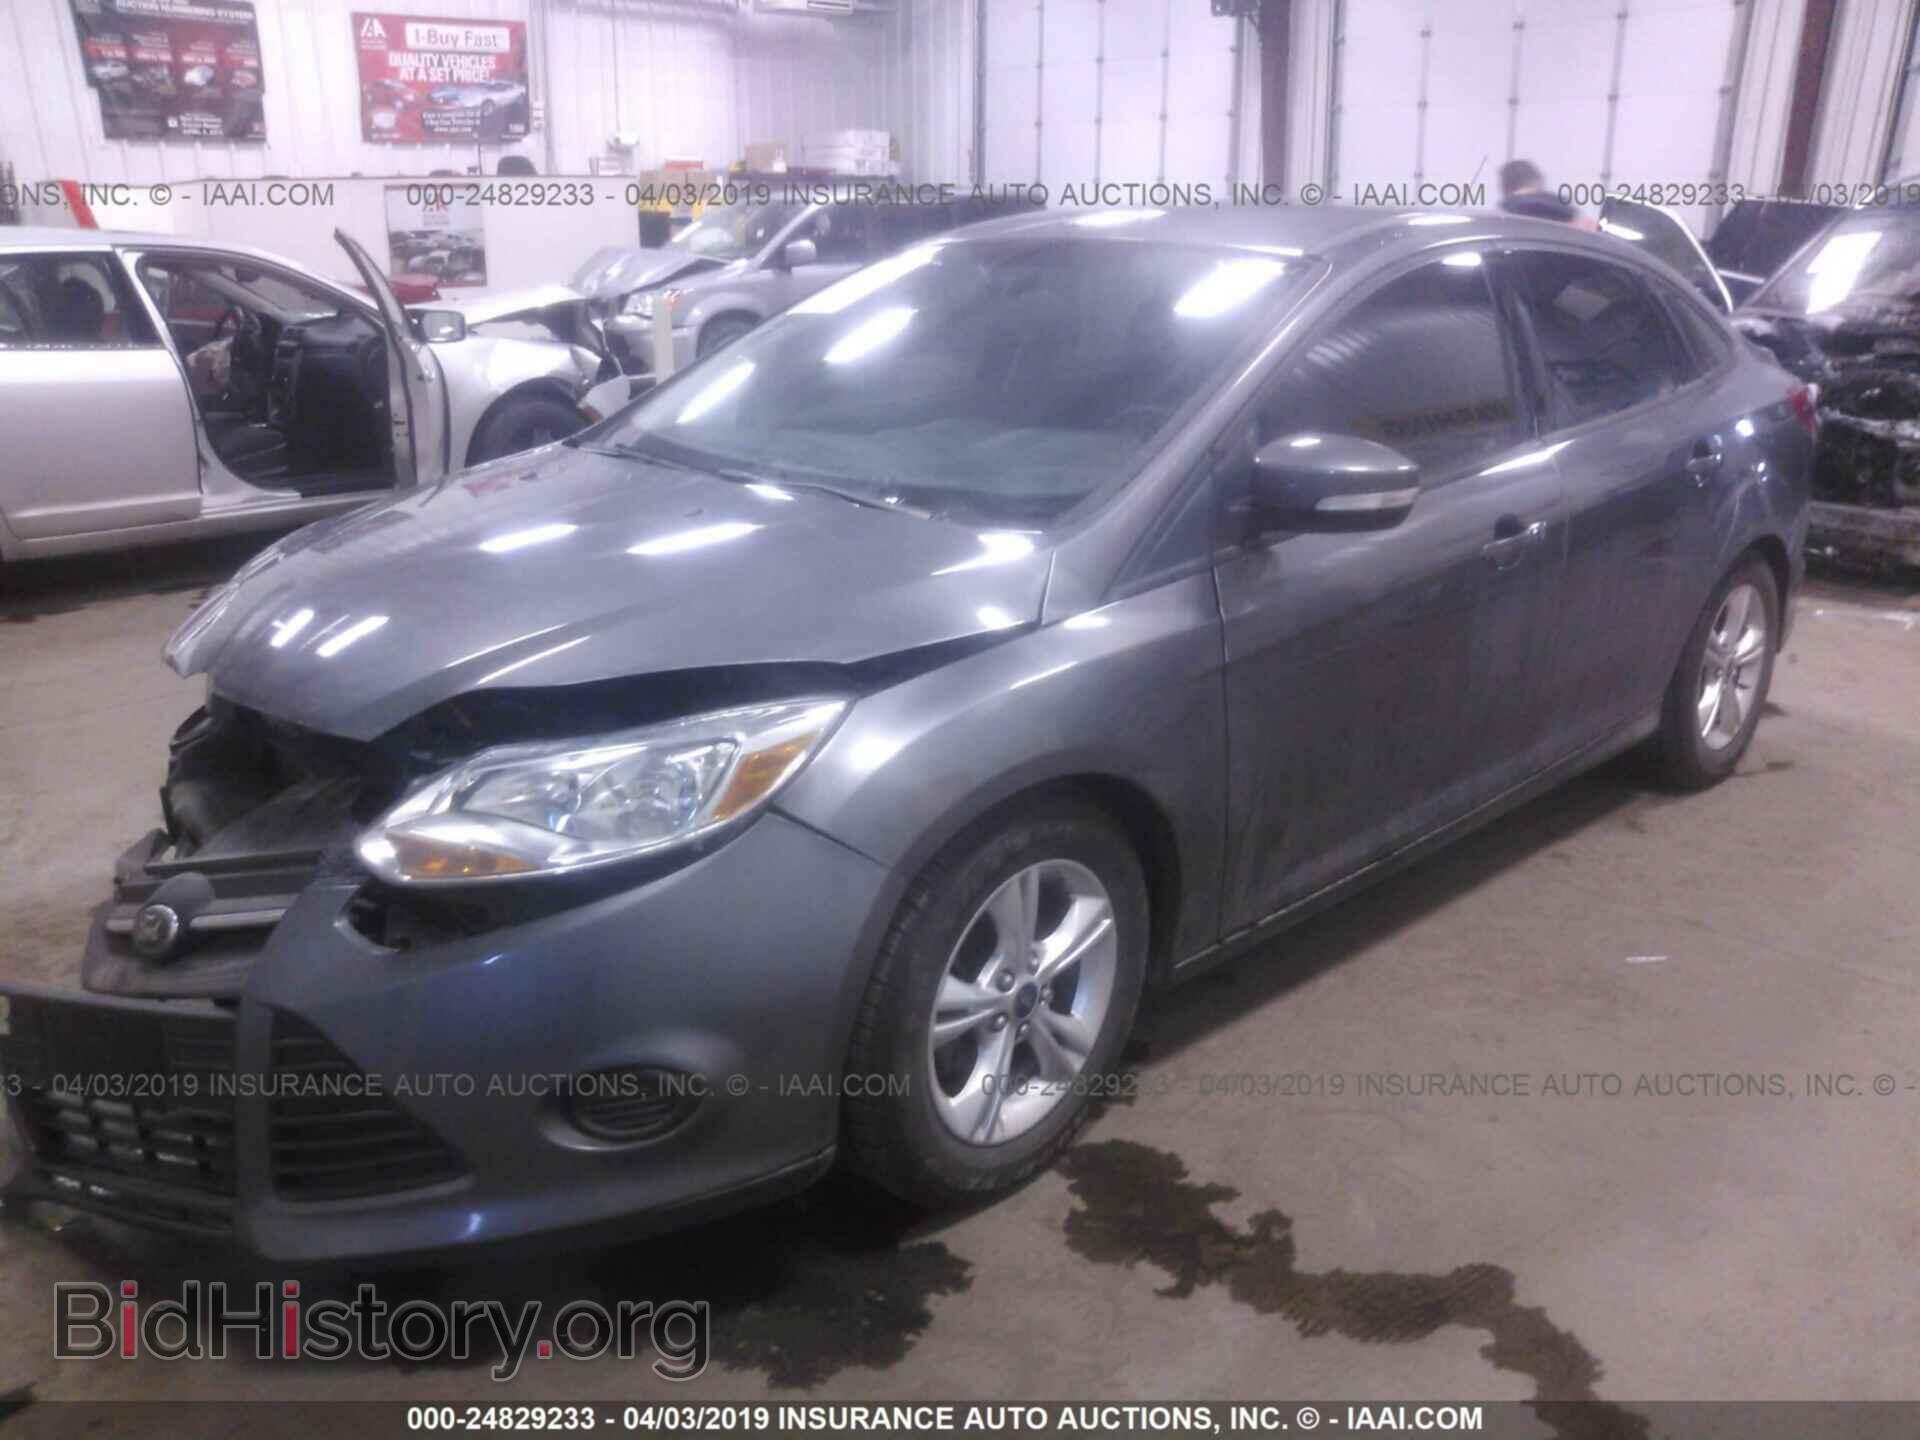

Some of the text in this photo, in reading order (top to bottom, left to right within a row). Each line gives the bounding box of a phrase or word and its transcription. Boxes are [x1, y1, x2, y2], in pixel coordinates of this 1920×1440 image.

[415, 27, 497, 48] I-Buy Fast
[389, 51, 497, 70] QUALITY VEHICLES
[399, 66, 416, 80] AT
[417, 67, 428, 81] A
[429, 67, 450, 81] SET
